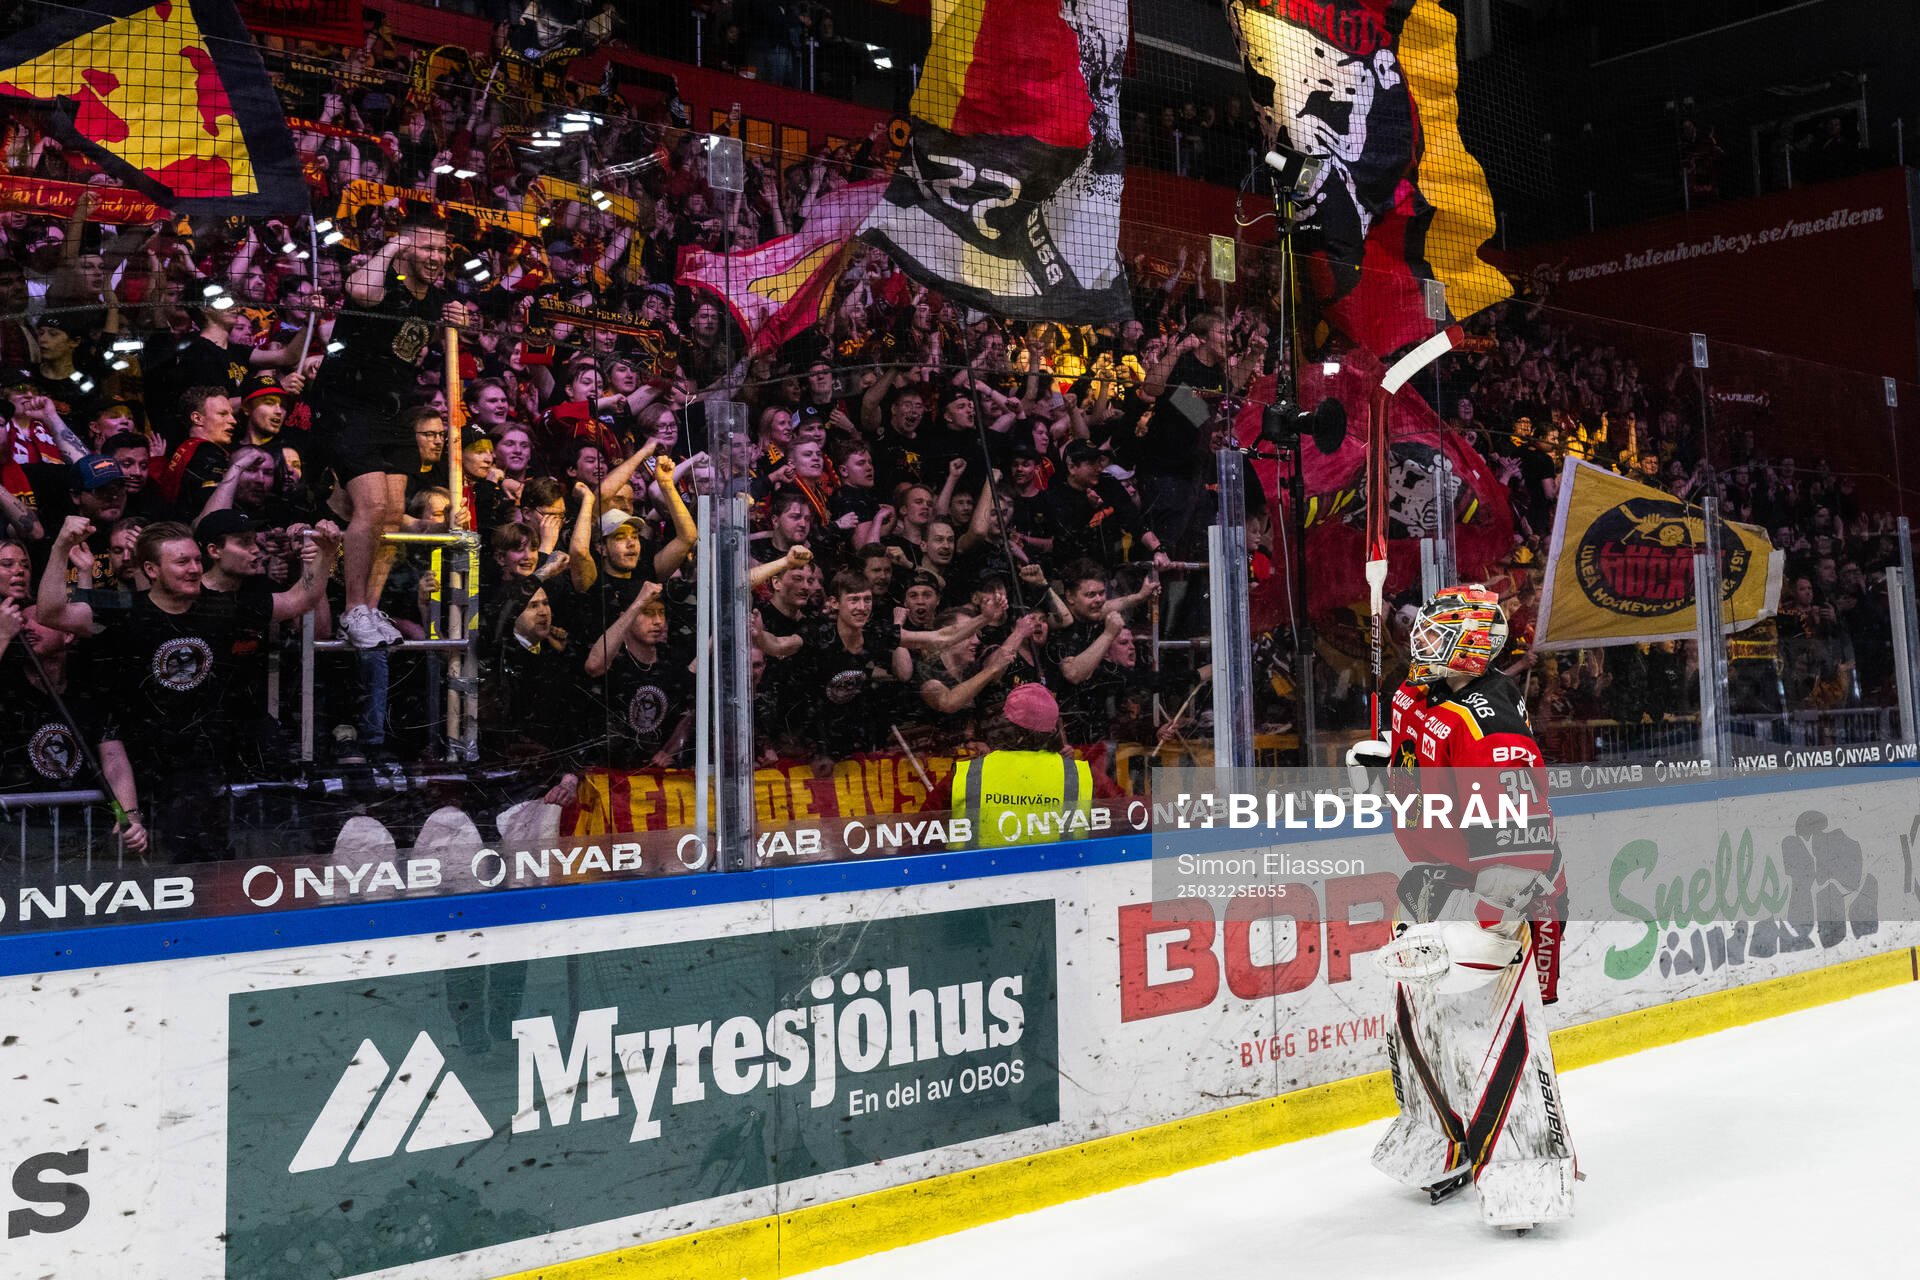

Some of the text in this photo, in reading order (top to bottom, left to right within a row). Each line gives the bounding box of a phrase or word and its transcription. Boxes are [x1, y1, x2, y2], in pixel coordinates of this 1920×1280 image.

[1371, 614, 1380, 676] BAUER
[1492, 746, 1537, 768] BDX
[1668, 759, 1712, 779] NYAB
[1739, 754, 1777, 773] NYAB
[1796, 751, 1833, 768] NYAB
[1846, 747, 1880, 763] NYAB
[1499, 769, 1538, 807] 34
[1597, 764, 1643, 785] NYAB
[876, 817, 973, 848] NYAB
[1027, 807, 1112, 836] NYAB
[516, 842, 642, 879] NYAB
[754, 828, 822, 858] YAB
[295, 858, 442, 897] NYAB
[19, 876, 195, 921] NYAB
[1603, 826, 1789, 980] Snells
[511, 967, 1025, 1143] Myresjöhus
[1241, 1033, 1296, 1068] BYGG
[849, 1059, 1025, 1116] En del av OBOS
[1538, 1069, 1565, 1147] BAUER
